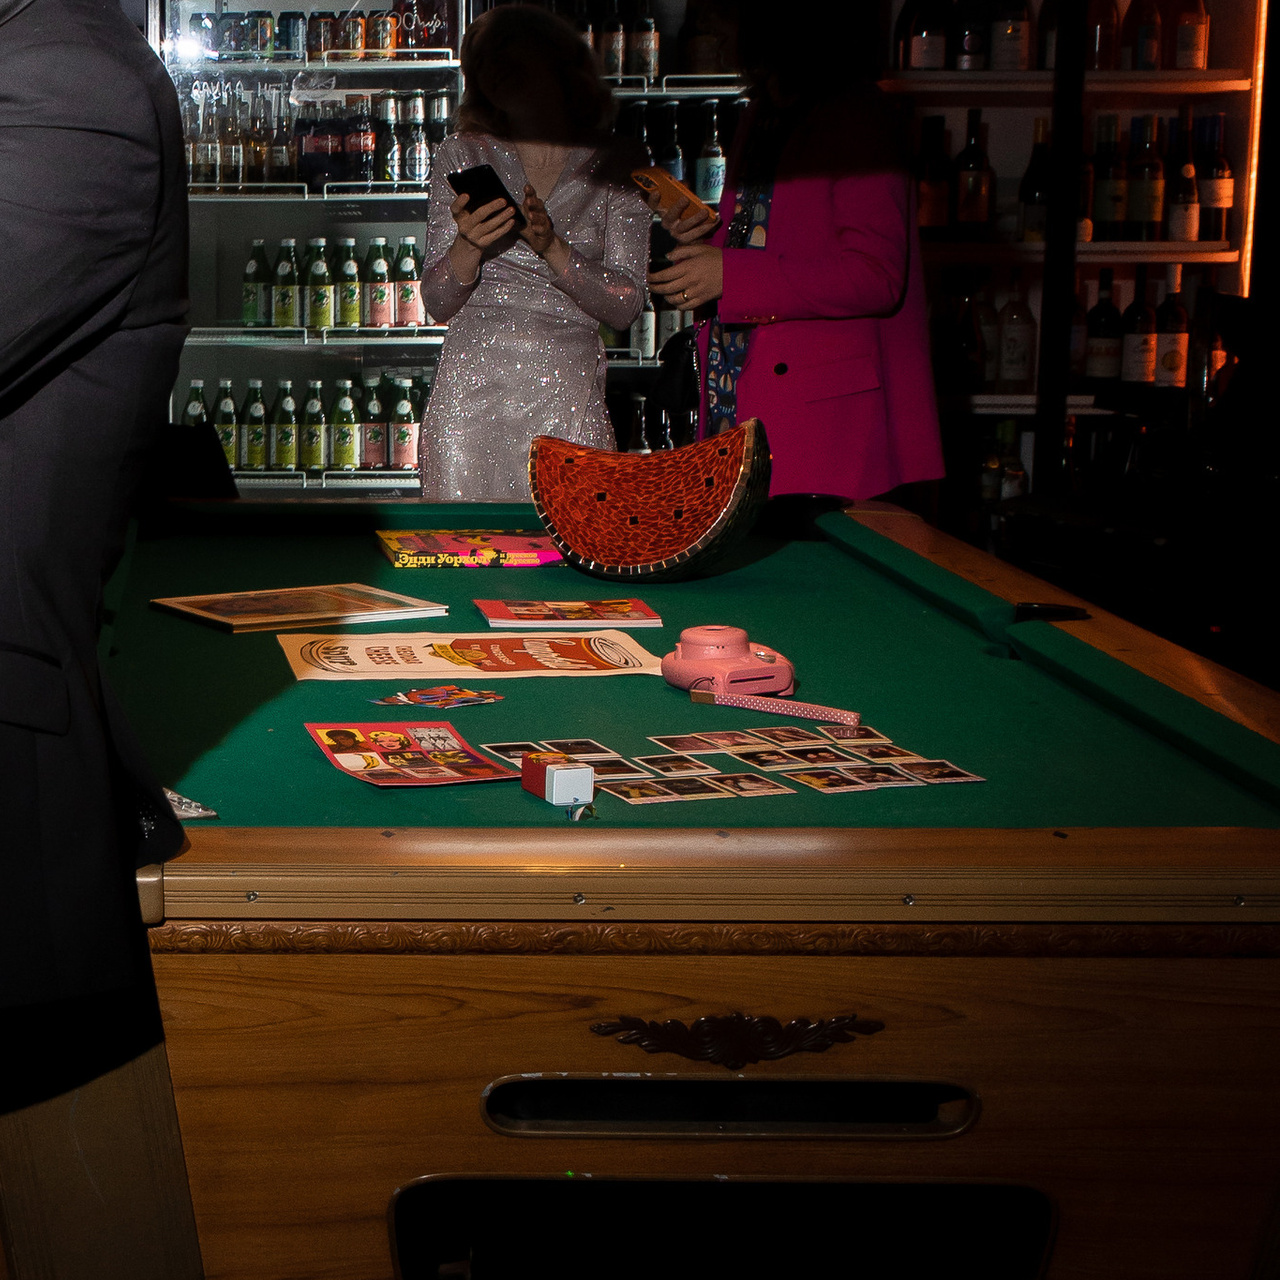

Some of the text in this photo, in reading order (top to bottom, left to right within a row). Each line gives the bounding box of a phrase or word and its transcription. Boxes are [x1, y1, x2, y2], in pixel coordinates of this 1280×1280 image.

[399, 553, 490, 567] Энди Уорхол
[321, 645, 358, 666] SOUP
[365, 645, 400, 665] CHEESE
[395, 645, 423, 664] CHEDDAR
